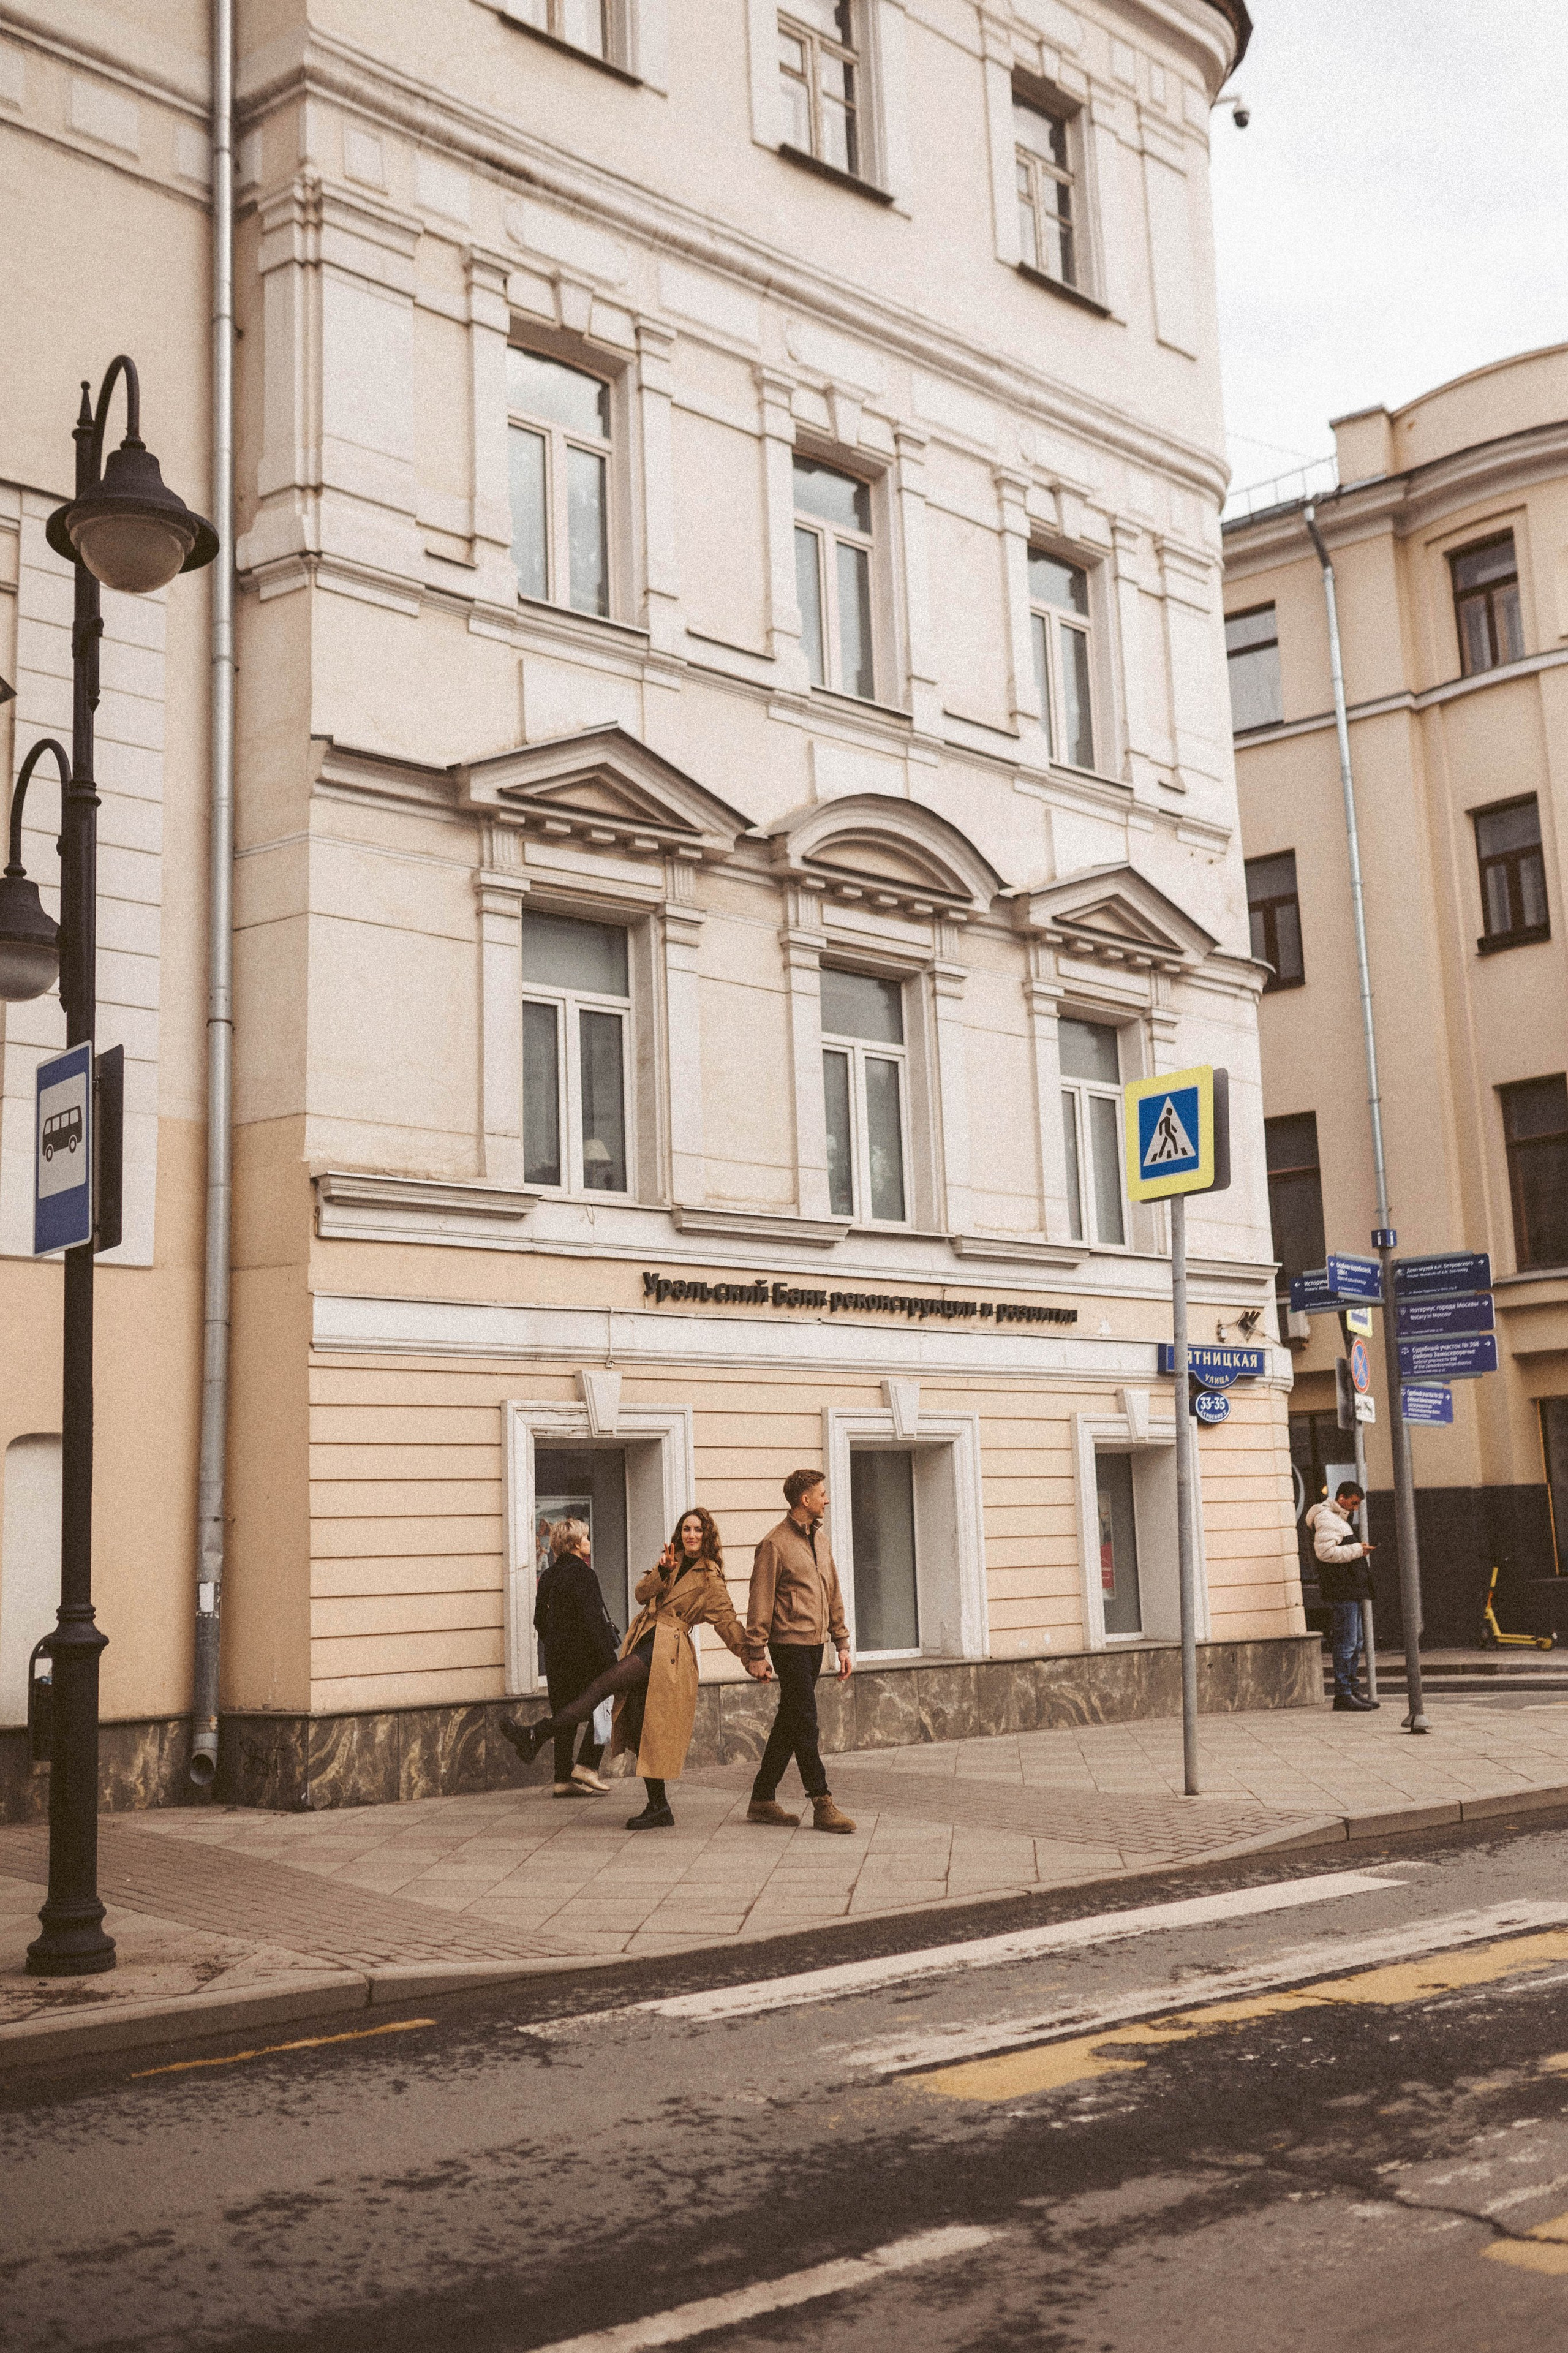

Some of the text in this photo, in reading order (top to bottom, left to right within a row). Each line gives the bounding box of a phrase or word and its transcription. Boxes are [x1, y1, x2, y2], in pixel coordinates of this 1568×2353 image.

[642, 1272, 1078, 1323] Уральский Банк реконструкции и развития
[1412, 1345, 1439, 1354] Судебный
[1187, 1350, 1258, 1368] ЯТНИЦКАЯ
[1205, 1373, 1229, 1384] УЛИЦА
[1200, 1397, 1226, 1410] 33-35
